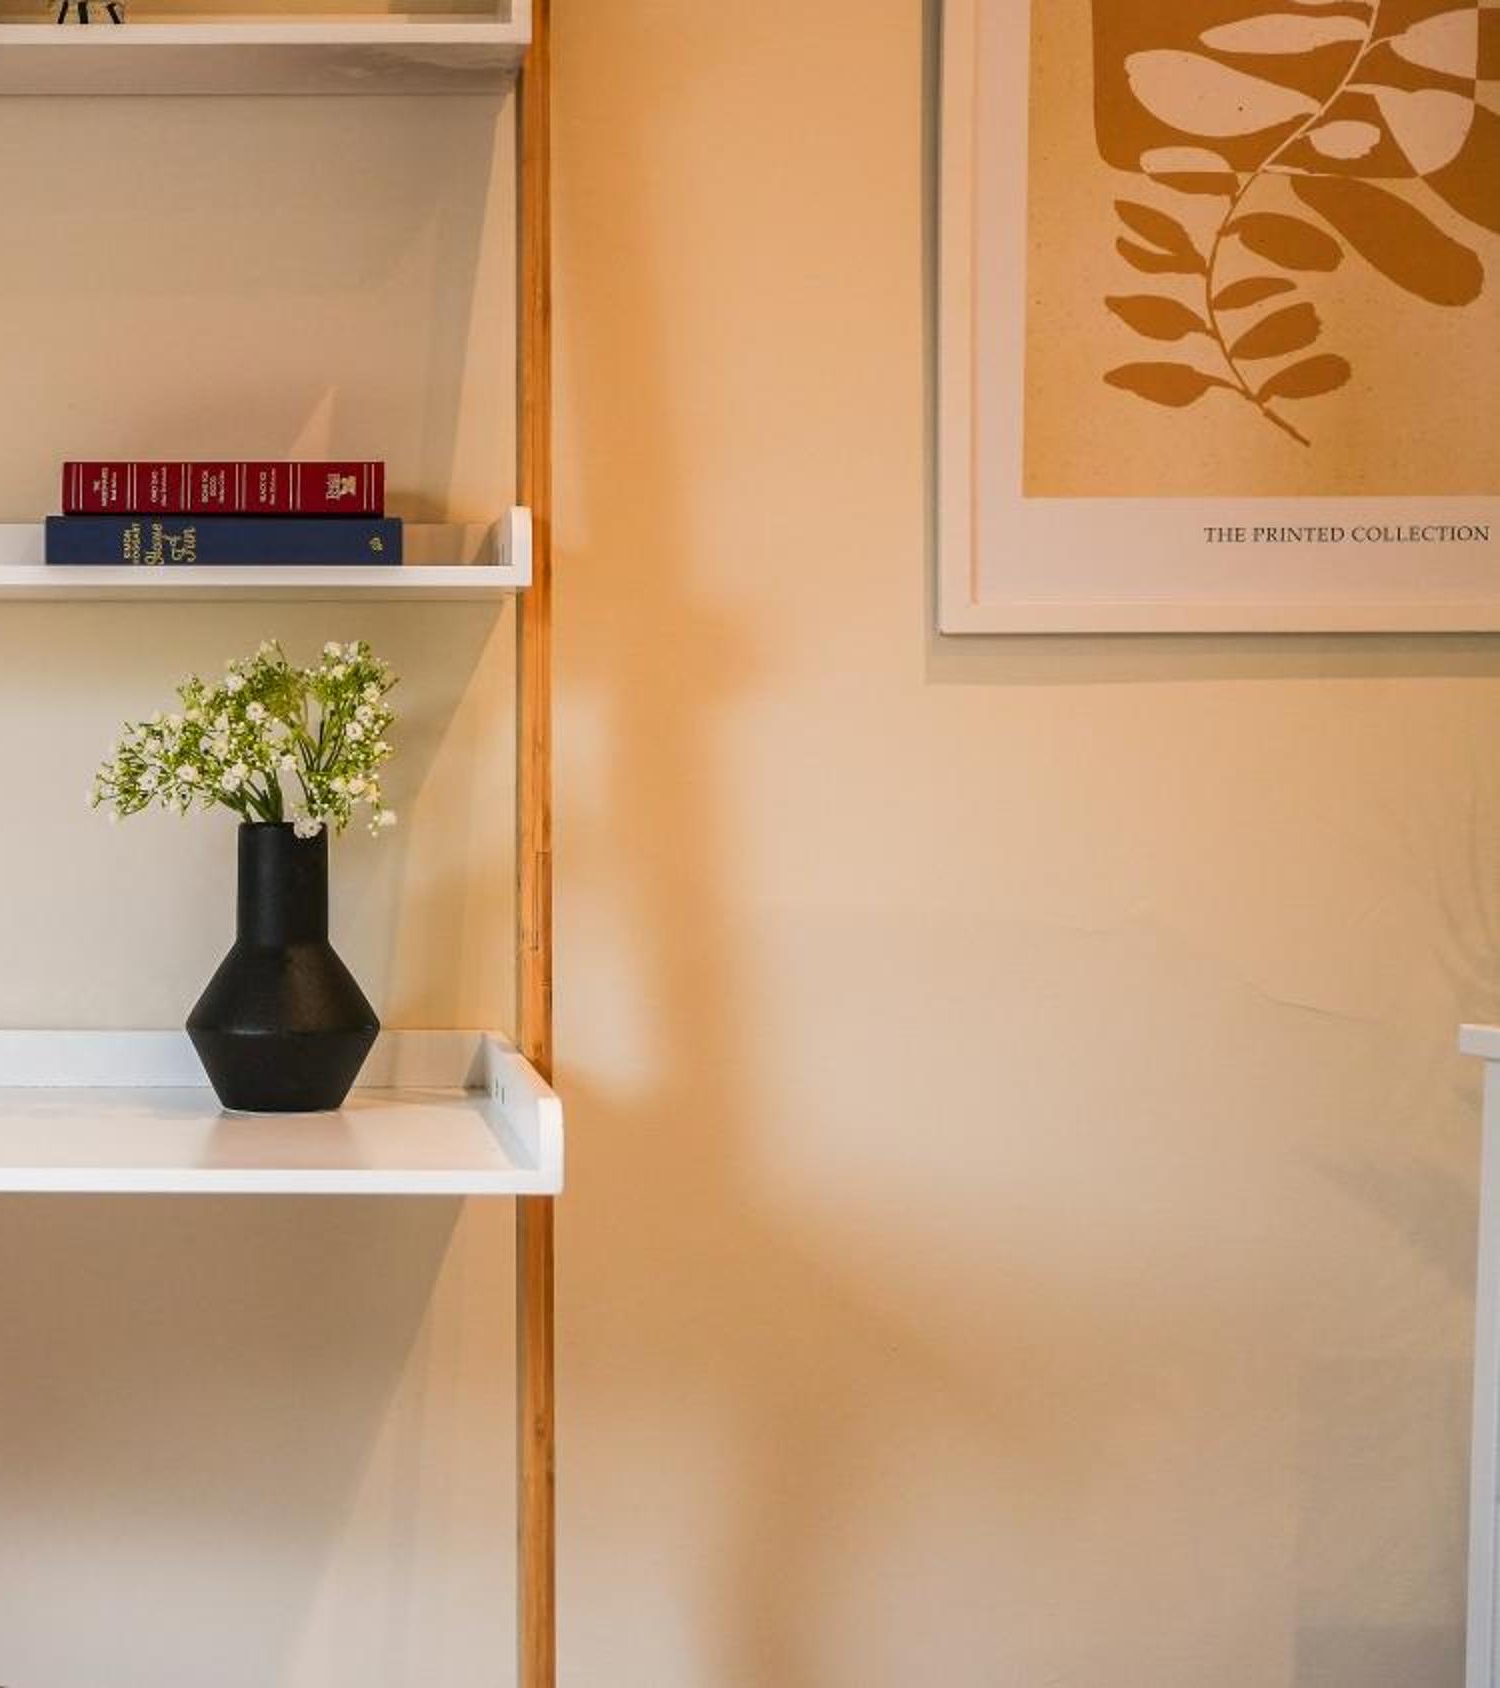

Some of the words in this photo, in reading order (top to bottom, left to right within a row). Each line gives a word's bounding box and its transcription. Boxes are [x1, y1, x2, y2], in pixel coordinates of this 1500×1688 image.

[1204, 527, 1247, 542] THE
[1253, 527, 1345, 542] PRINTED
[1351, 525, 1491, 542] COLLECTION
